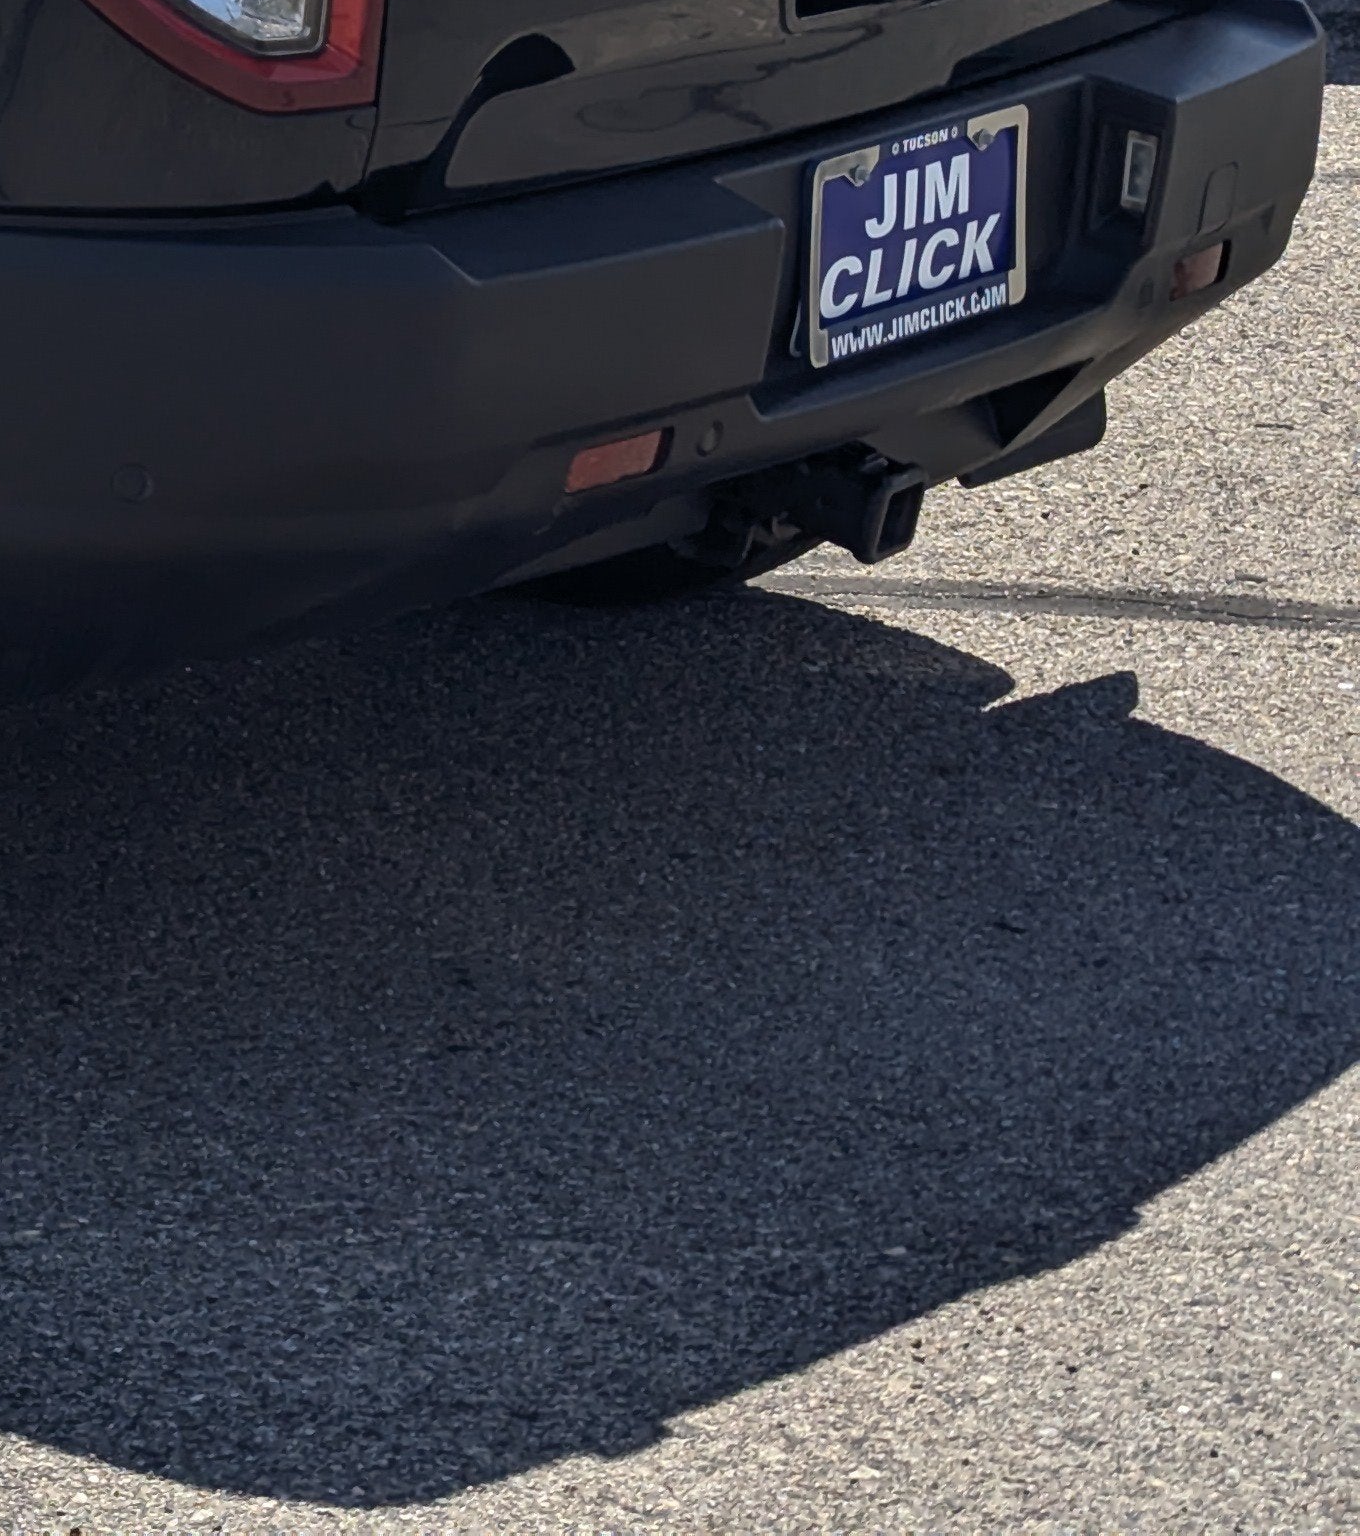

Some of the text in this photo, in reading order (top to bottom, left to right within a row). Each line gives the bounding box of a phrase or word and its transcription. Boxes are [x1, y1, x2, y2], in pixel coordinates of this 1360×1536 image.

[902, 128, 949, 153] TUCSON
[865, 153, 970, 239] JIM
[819, 213, 1001, 319] CLICK
[831, 283, 1007, 359] WWW.JIMCLICK.COM
